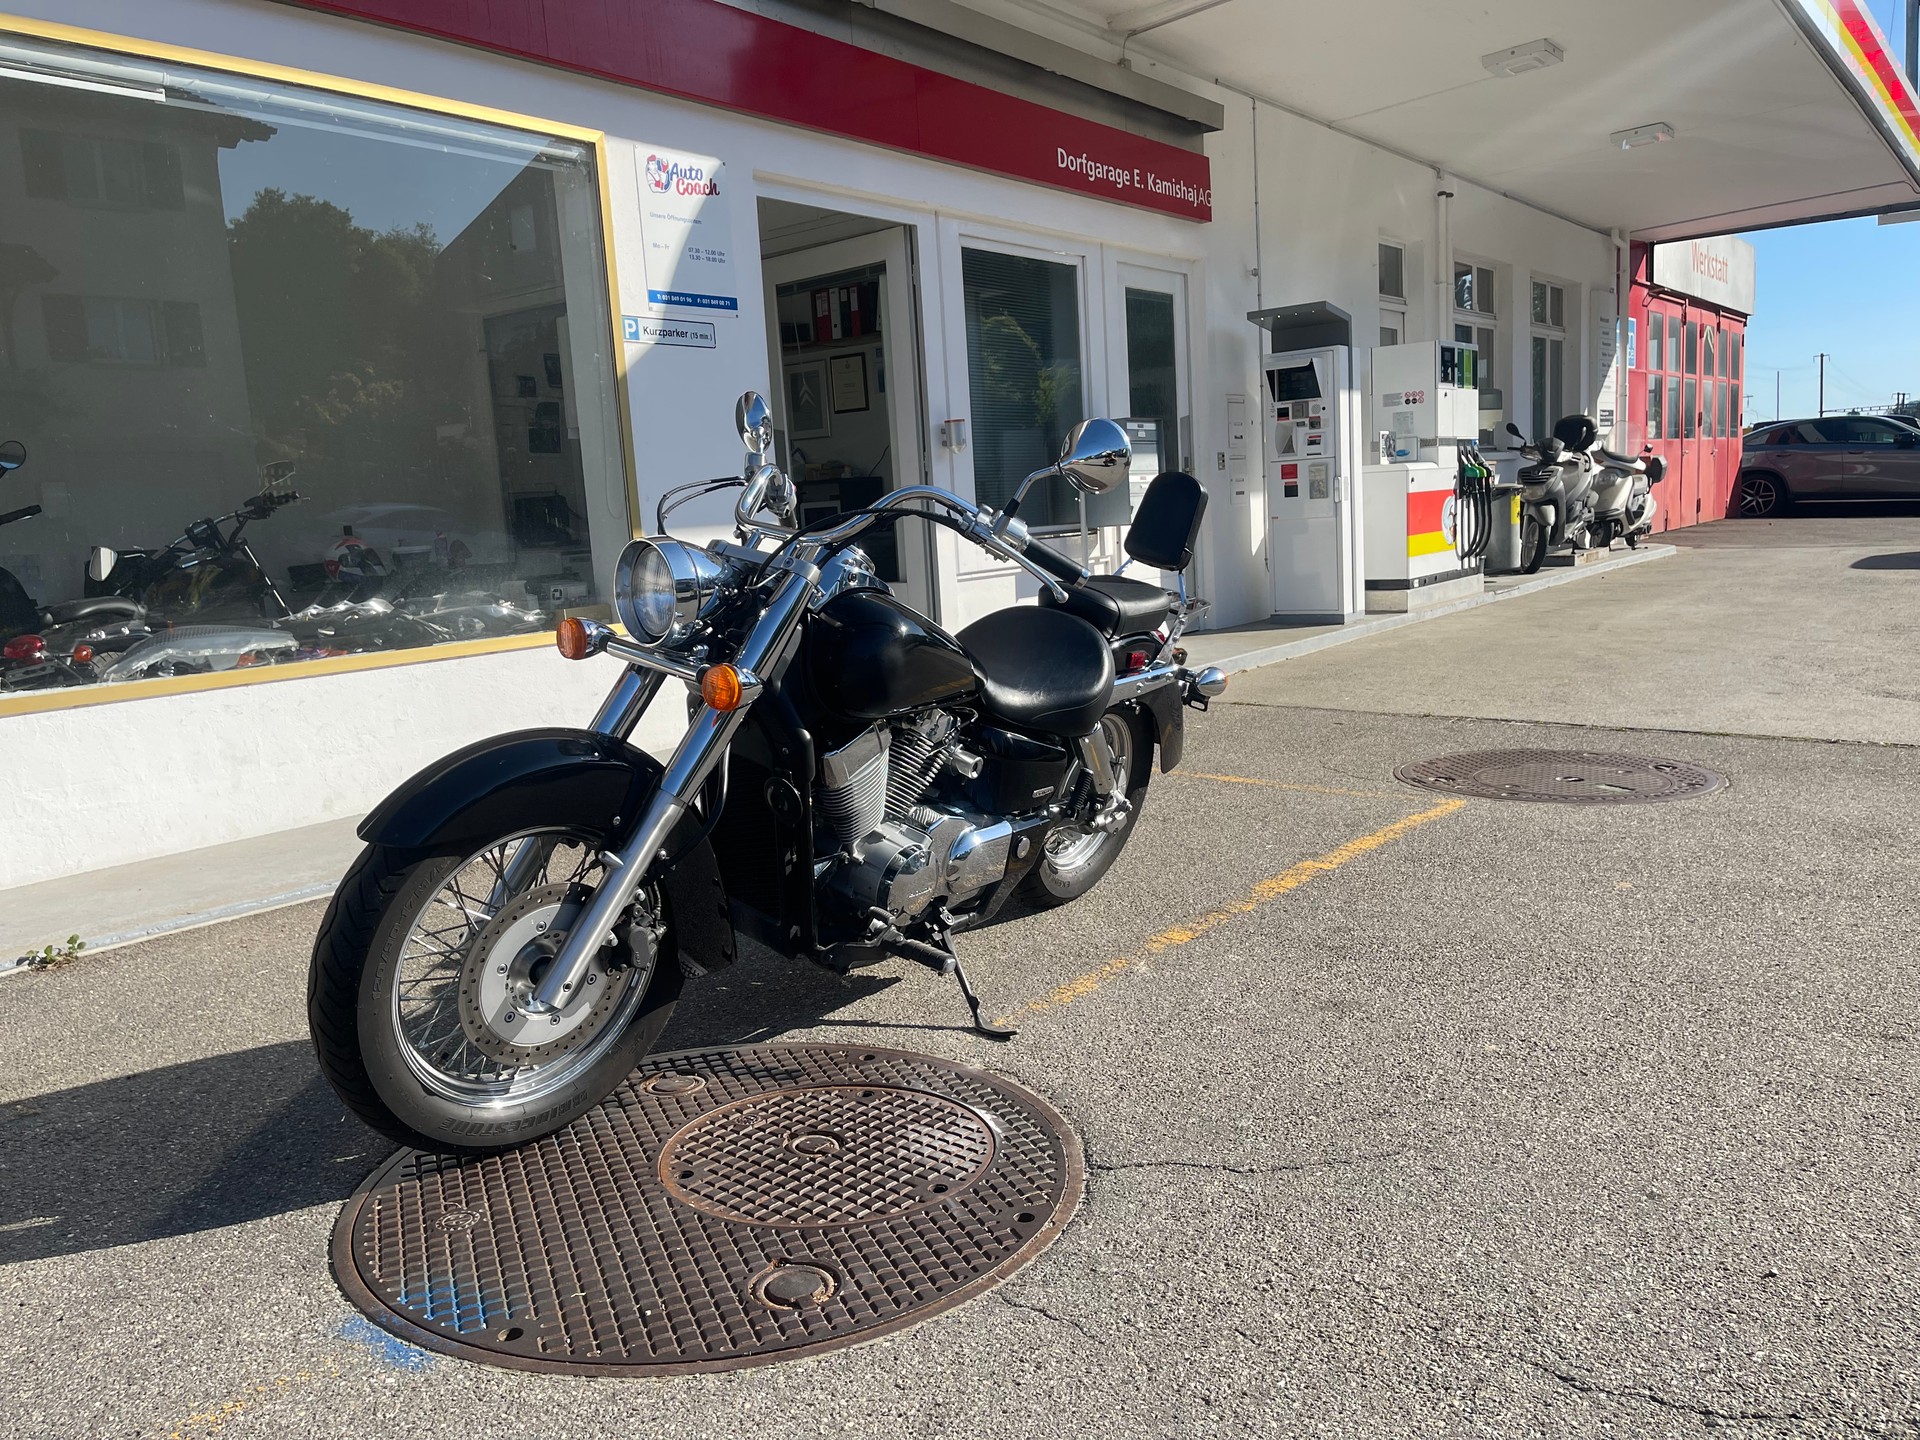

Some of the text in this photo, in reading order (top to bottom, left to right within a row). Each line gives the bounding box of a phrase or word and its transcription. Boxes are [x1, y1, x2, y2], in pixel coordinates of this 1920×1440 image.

[670, 162, 703, 181] Auto
[676, 178, 721, 196] Coach
[1057, 147, 1211, 207] Dorfgarage E. Kamishaj AG
[1691, 240, 1728, 284] Werkstatt
[624, 320, 637, 339] P
[643, 326, 688, 340] Kurzparker
[437, 1088, 588, 1137] BRIDGESTONE
